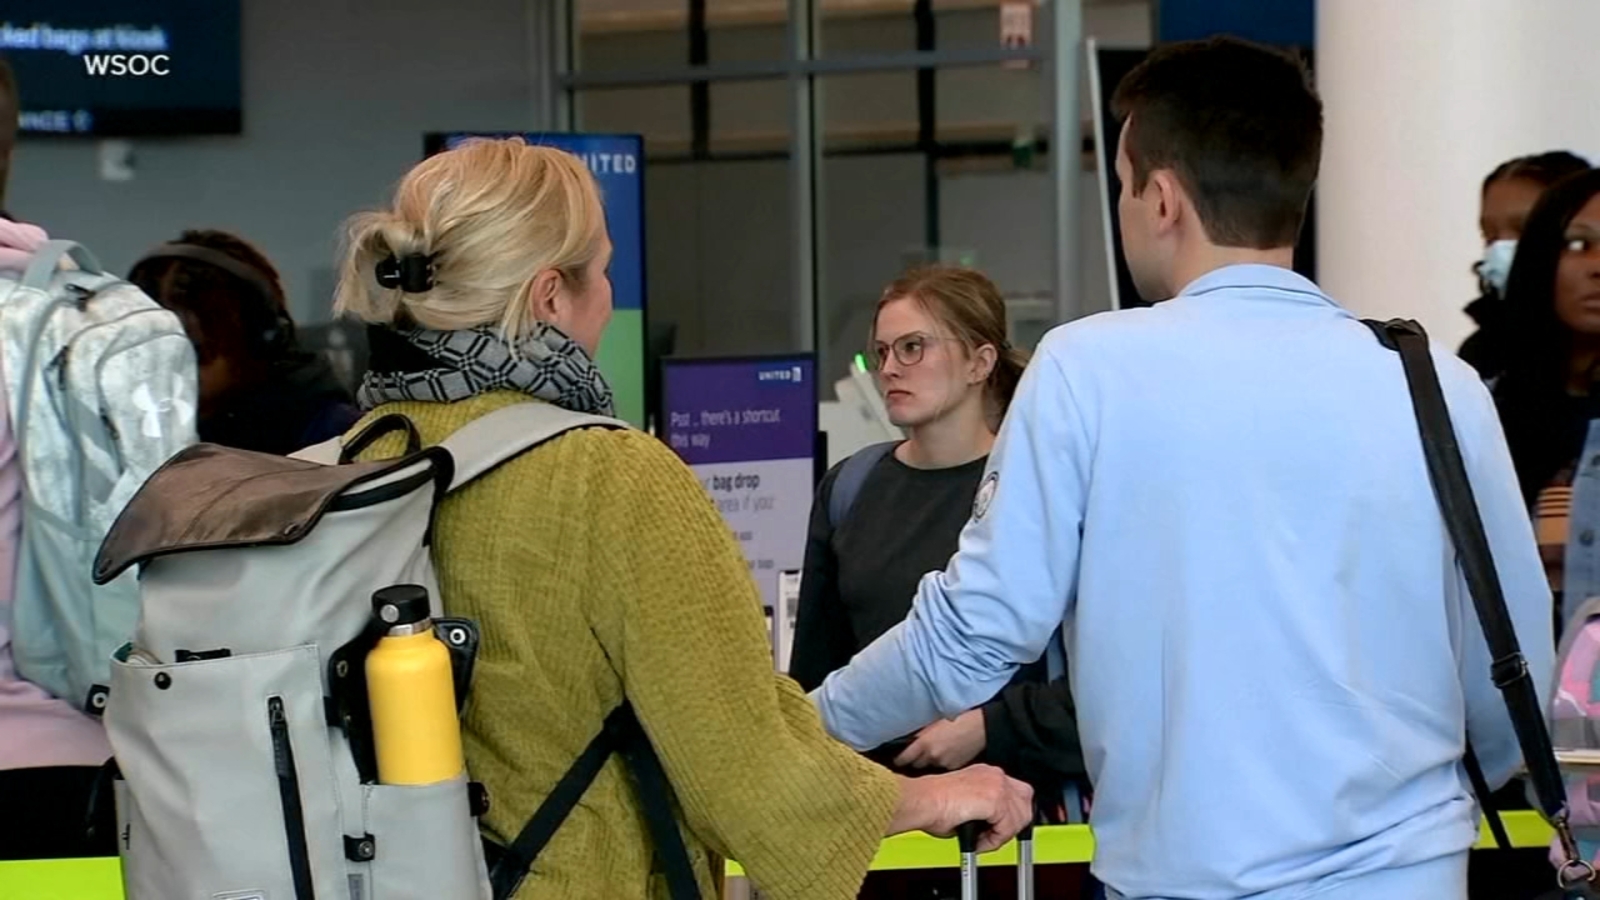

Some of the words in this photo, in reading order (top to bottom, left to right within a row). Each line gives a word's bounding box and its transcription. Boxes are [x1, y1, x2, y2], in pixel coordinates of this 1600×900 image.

[758, 371, 790, 381] UNITED
[690, 433, 711, 449] way
[713, 474, 733, 492] bag
[734, 472, 760, 490] drop
